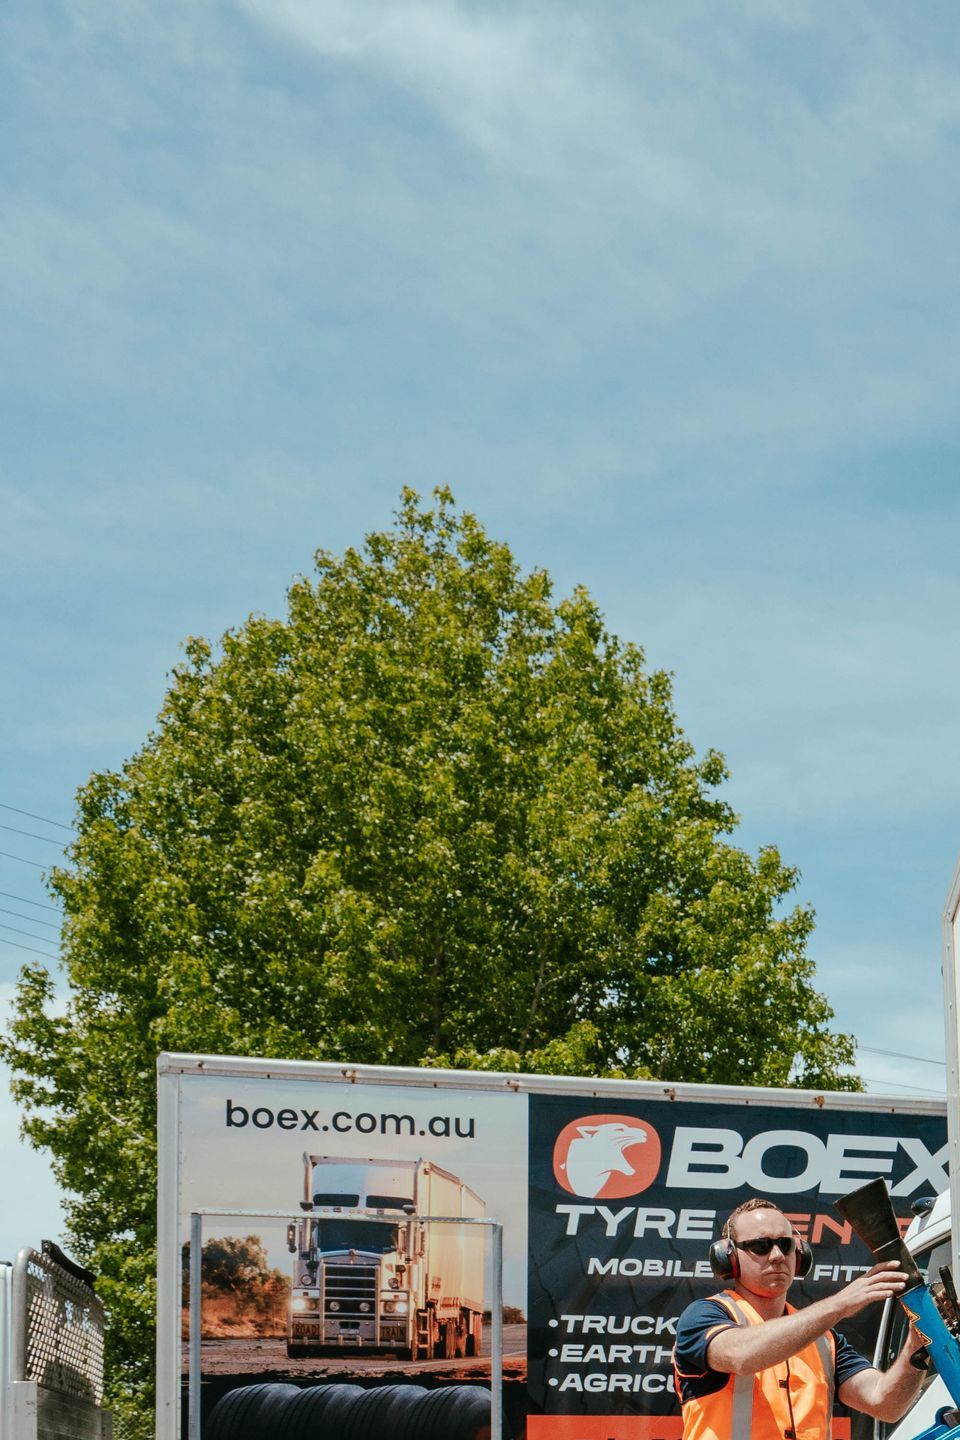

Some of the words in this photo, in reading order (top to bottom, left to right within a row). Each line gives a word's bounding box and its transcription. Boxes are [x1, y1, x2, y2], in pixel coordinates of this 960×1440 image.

[226, 1099, 476, 1139] boex.com.au
[665, 1126, 950, 1198] BOEX
[555, 1203, 718, 1240] TYRE
[587, 1257, 715, 1279] MOBILE
[560, 1314, 680, 1335] TRUCK
